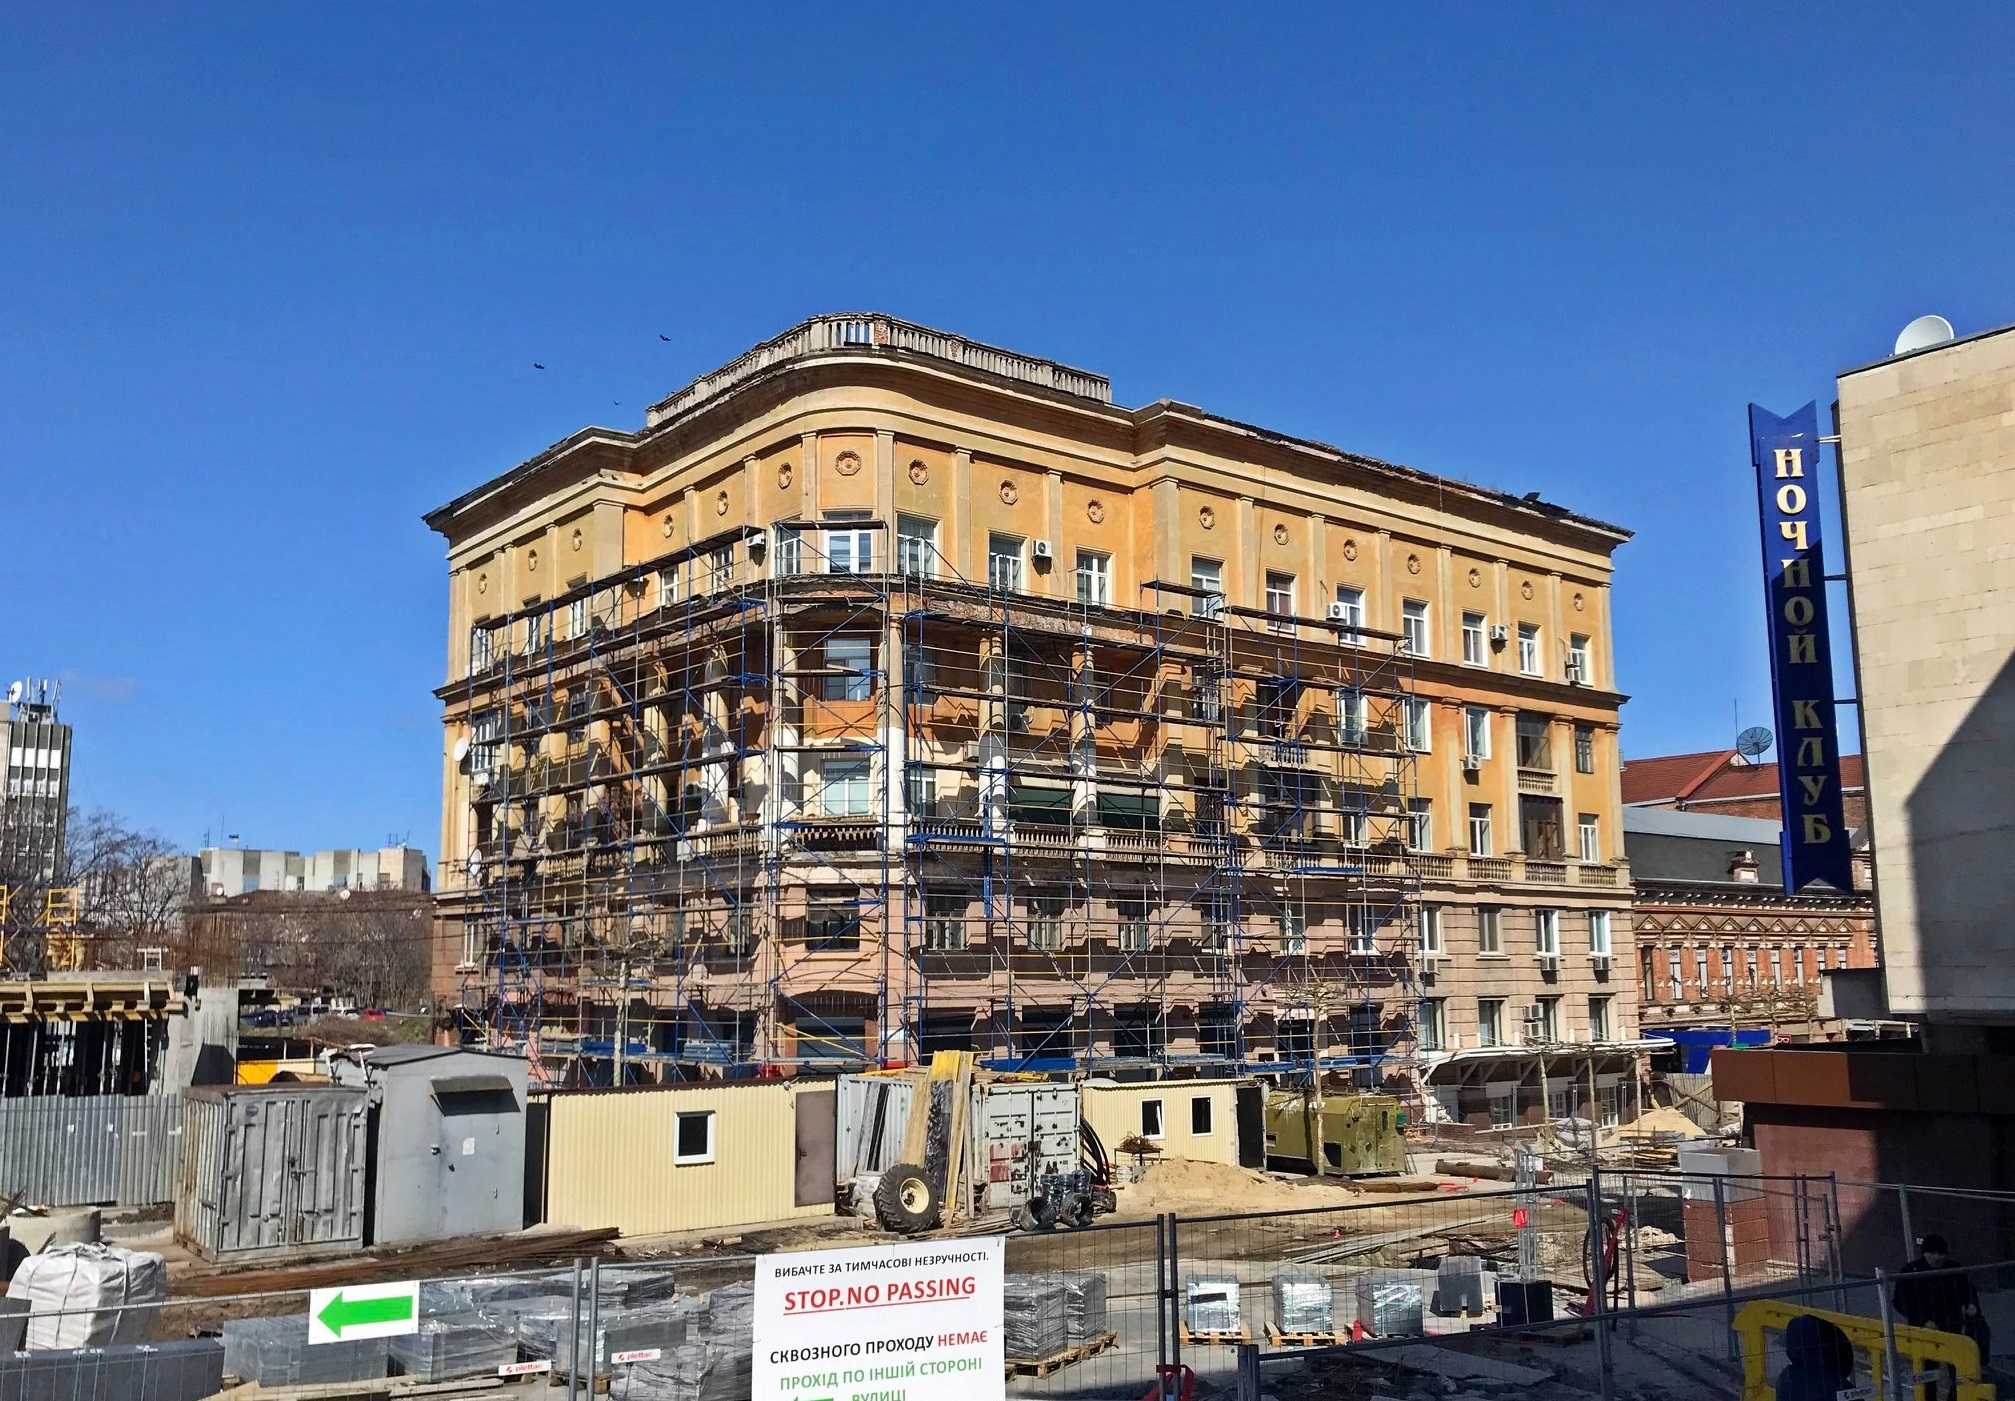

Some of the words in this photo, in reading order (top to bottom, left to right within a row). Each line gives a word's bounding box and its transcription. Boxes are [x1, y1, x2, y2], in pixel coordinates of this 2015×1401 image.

[1773, 448, 1818, 664] НОЧНОЙ
[1793, 699, 1831, 844] КЛУБ
[774, 1264, 825, 1278] ВИБАЧТЕ
[828, 1263, 842, 1274] ЗА
[845, 1258, 912, 1272] ТИМЧАСОВІ
[915, 1252, 989, 1267] НЕЗРУЧНОСТІ.
[887, 1276, 976, 1301] PASSING
[770, 1343, 861, 1364] СКВОЗНОГО
[866, 1335, 934, 1355] ПРОХОДУ
[938, 1330, 988, 1347] НЕМАЄ
[780, 1371, 838, 1391] ПРОХІД
[843, 1369, 865, 1384] ПО
[870, 1361, 915, 1381] ІНШІЙ
[920, 1357, 983, 1376] СТОРОНІ
